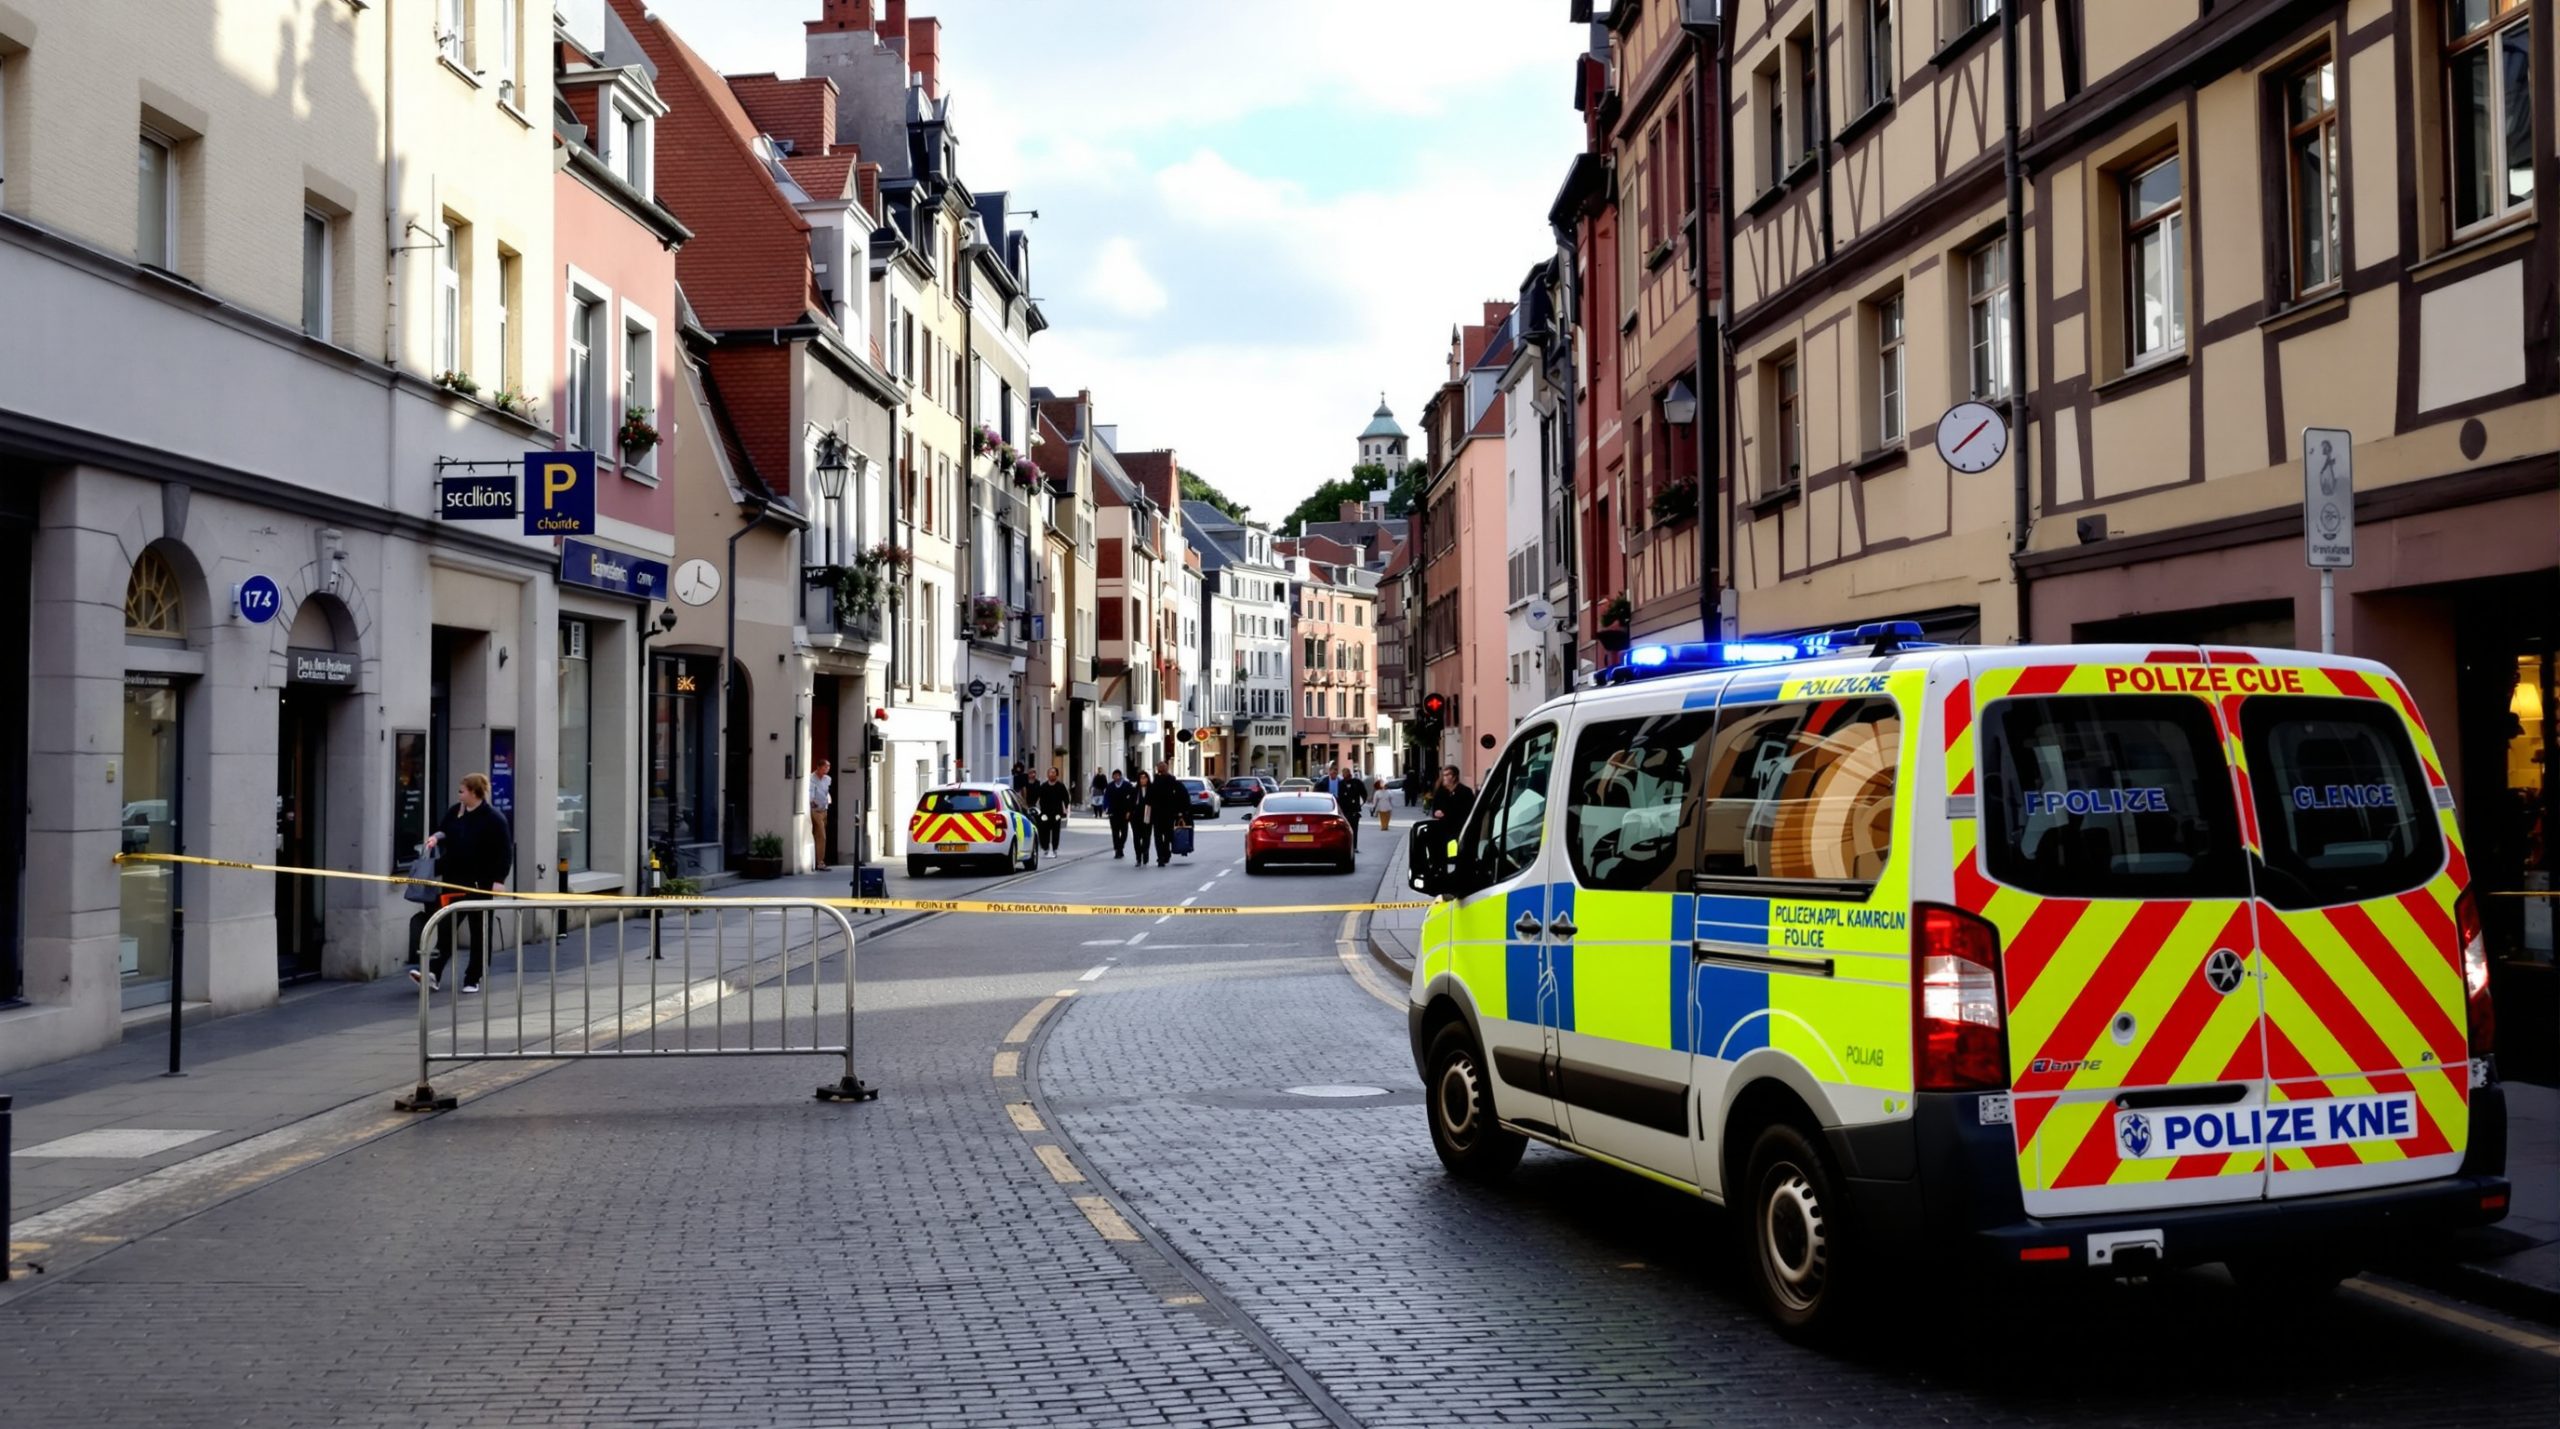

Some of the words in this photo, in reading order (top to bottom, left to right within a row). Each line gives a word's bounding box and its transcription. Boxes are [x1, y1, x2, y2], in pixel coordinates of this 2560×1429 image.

[544, 463, 577, 510] P
[2104, 667, 2232, 693] POLIZE
[2236, 668, 2304, 693] CUE
[2164, 1106, 2317, 1151] POLIZE
[2328, 1099, 2409, 1140] KNE
